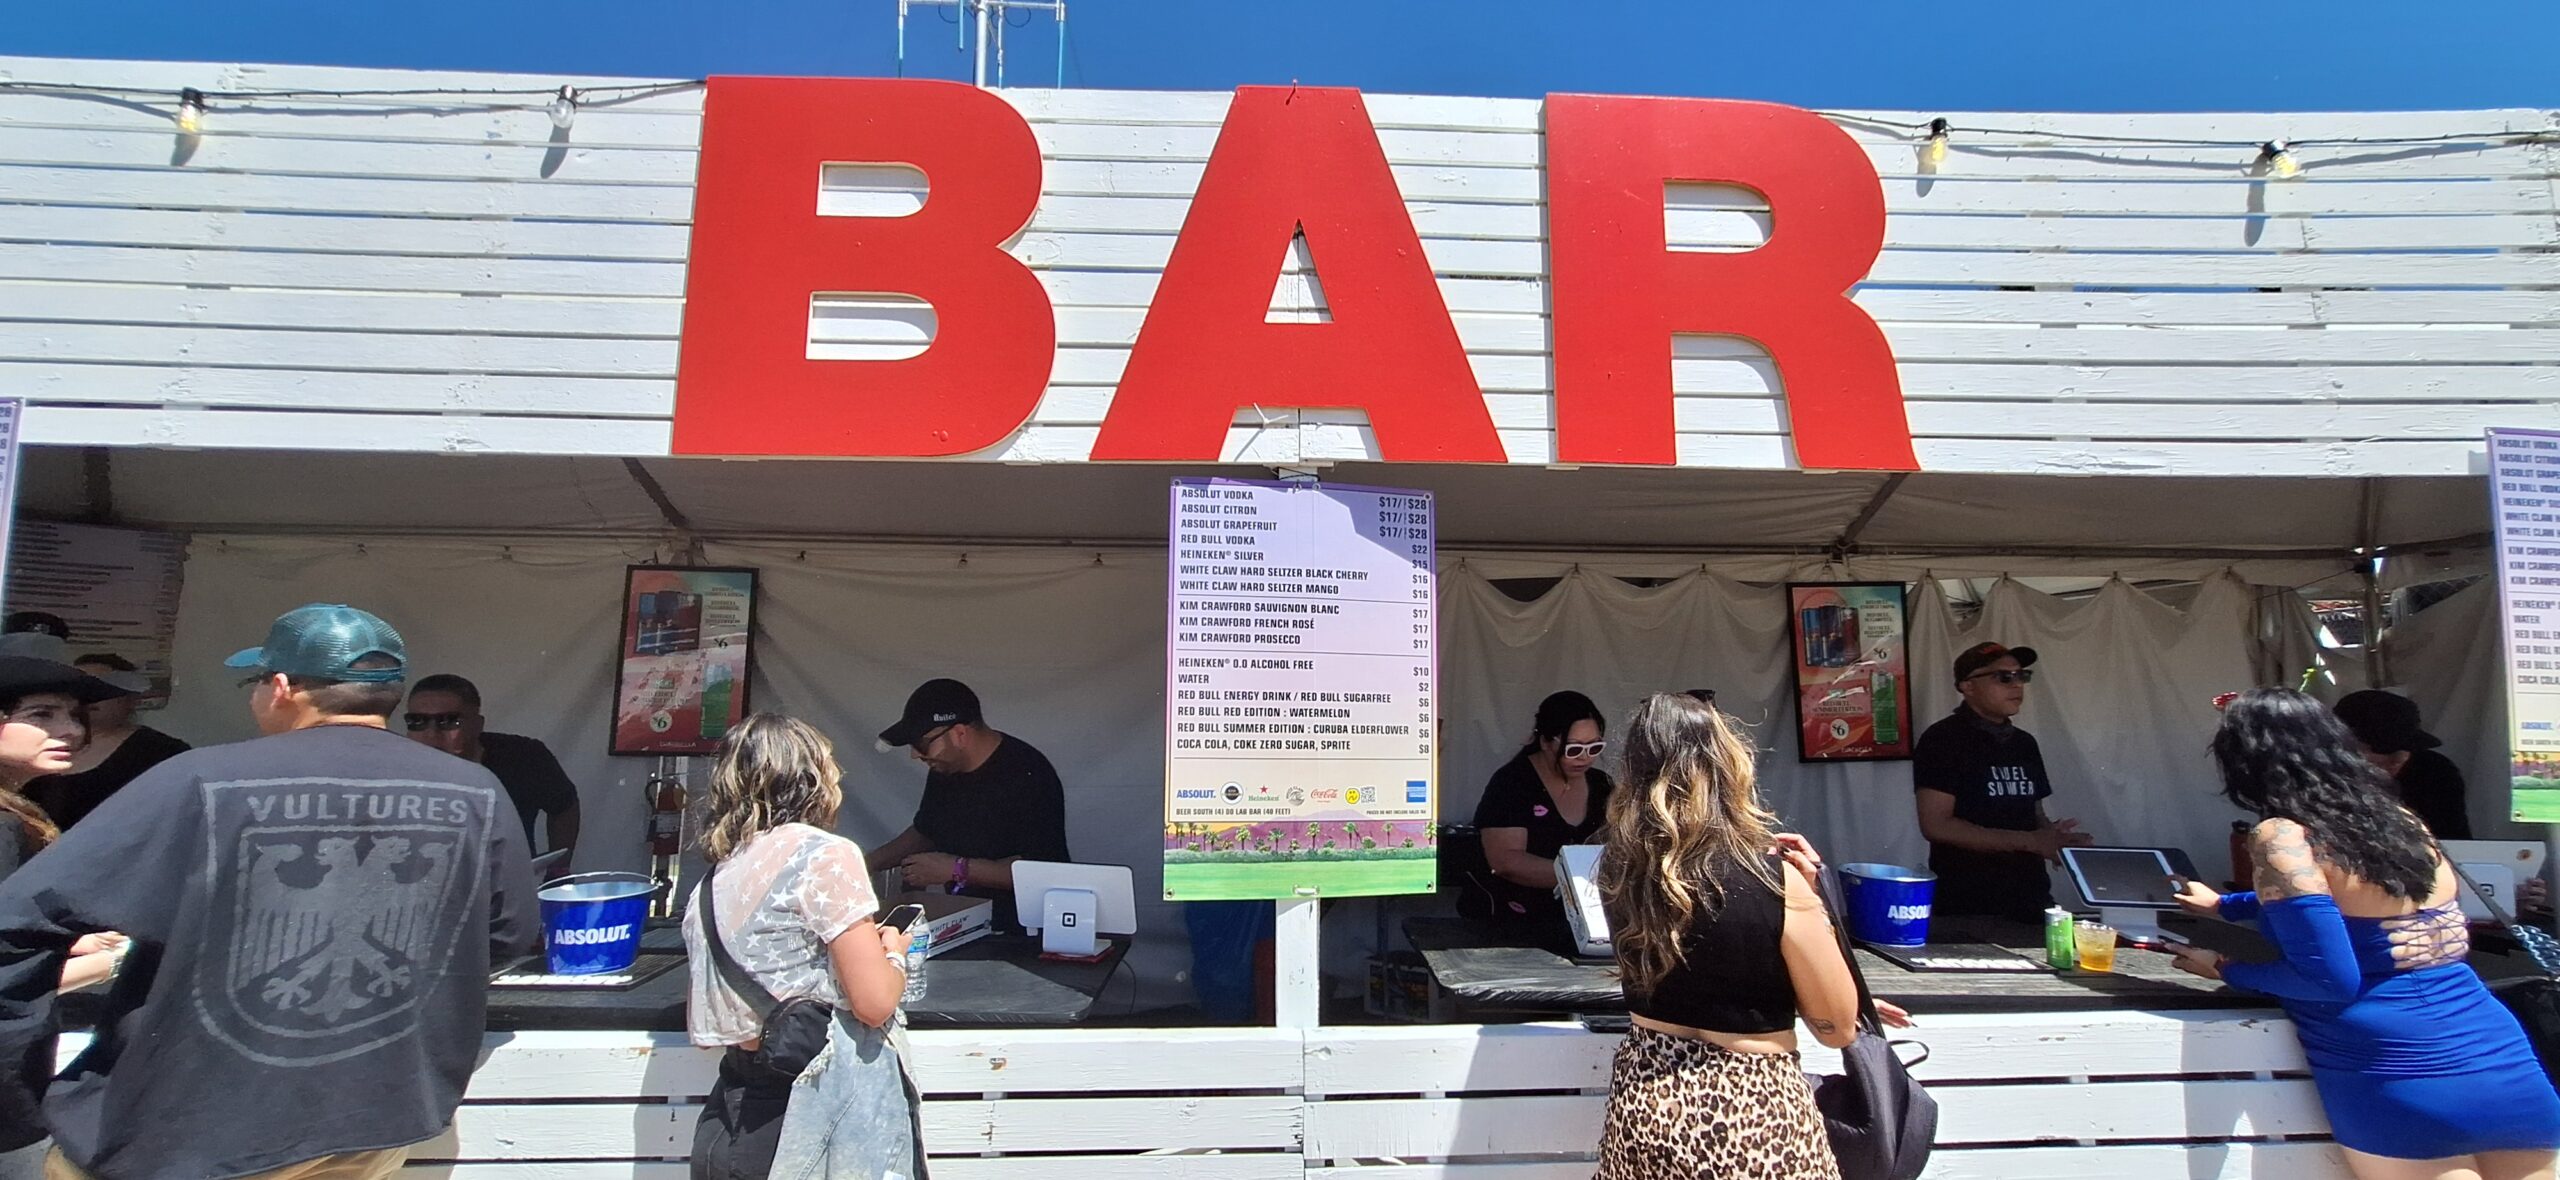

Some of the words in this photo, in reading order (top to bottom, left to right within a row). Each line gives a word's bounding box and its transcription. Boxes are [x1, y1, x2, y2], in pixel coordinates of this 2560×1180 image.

[671, 75, 1919, 470] BAR
[1182, 487, 1220, 498] ABSOLUT
[1224, 491, 1253, 499] VODKA
[1409, 498, 1426, 510] $28
[1182, 504, 1220, 513] ABSOLUT
[1224, 506, 1256, 514] CITRON
[1409, 513, 1427, 524] $28
[1181, 519, 1220, 528] ABSOLUT
[1224, 521, 1276, 530] GRAPEFRUIT
[1409, 528, 1427, 540] $28
[1181, 535, 1197, 543] RED
[1202, 535, 1222, 544] BULL
[1226, 536, 1255, 545] VODKA
[1412, 545, 1427, 554] $22
[1234, 552, 1263, 560] SILVER
[1413, 560, 1428, 569] $15
[1181, 565, 1208, 574] WHITE
[1213, 566, 1237, 575] CLAW
[1241, 567, 1264, 576] HARD
[1268, 568, 1302, 577] SELTZER
[1306, 569, 1332, 578] BLACK
[1336, 571, 1368, 580] CHERRY
[1413, 575, 1428, 584] $16
[1180, 581, 1208, 590] WHITE
[1212, 582, 1237, 590] CLAW
[1241, 583, 1264, 591] HARD
[1268, 583, 1302, 592] SELTZER
[1306, 585, 1338, 594] MANGO
[1413, 590, 1428, 599] $16
[1180, 601, 1198, 609] KIM
[1202, 602, 1251, 611] CRAWFORD
[1255, 603, 1307, 612] SAUVIGNON
[1311, 605, 1339, 614] BLANC
[1413, 610, 1428, 619] $17
[1180, 617, 1197, 625] KIM
[1202, 618, 1251, 627] CRAWFORD
[1255, 619, 1289, 628] FRENCH
[1292, 618, 1314, 629] ROSÉ
[1413, 625, 1428, 634] $17
[1180, 633, 1197, 641] KIM
[1201, 633, 1251, 642] CRAWFORD
[1255, 635, 1300, 644] PROSECCO
[1413, 639, 1428, 649] $17
[1233, 659, 1247, 668] 0.0
[1251, 660, 1290, 669] ALCOHOL
[1294, 661, 1313, 669] FREE
[1414, 667, 1428, 676] $10
[1179, 674, 1209, 683] WATER
[1419, 683, 1429, 692] $2
[1178, 690, 1195, 699] RED
[1199, 691, 1220, 700] BULL
[1224, 691, 1259, 700] ENERGY
[1263, 692, 1291, 700] DRINK
[1301, 692, 1317, 701] RED
[1321, 693, 1339, 701] BULL
[1344, 694, 1390, 702] SUGARFREE
[1419, 698, 1429, 707] $6
[1178, 707, 1195, 715] RED
[1199, 707, 1220, 716] BULL
[1224, 707, 1240, 716] RED
[1245, 708, 1280, 717] EDITION
[1290, 708, 1350, 717] WATERMELON
[1419, 714, 1429, 723] $6
[1178, 723, 1194, 732] RED
[1199, 723, 1219, 732] BULL
[1224, 724, 1265, 732] SUMMER
[1269, 724, 1304, 733] EDITION
[1314, 725, 1348, 733] CURUBA
[1352, 725, 1408, 734] ELDERFLOWER
[1419, 729, 1429, 738] $6
[1178, 739, 1201, 748] COCA
[1205, 740, 1230, 750] COLA,
[1234, 740, 1256, 749] COKE
[1261, 740, 1282, 749] ZERO
[1286, 740, 1317, 749] SUGAR,
[1321, 741, 1350, 749] SPRITE
[1991, 766, 2028, 780] CUEL
[246, 794, 468, 823] VULTURES
